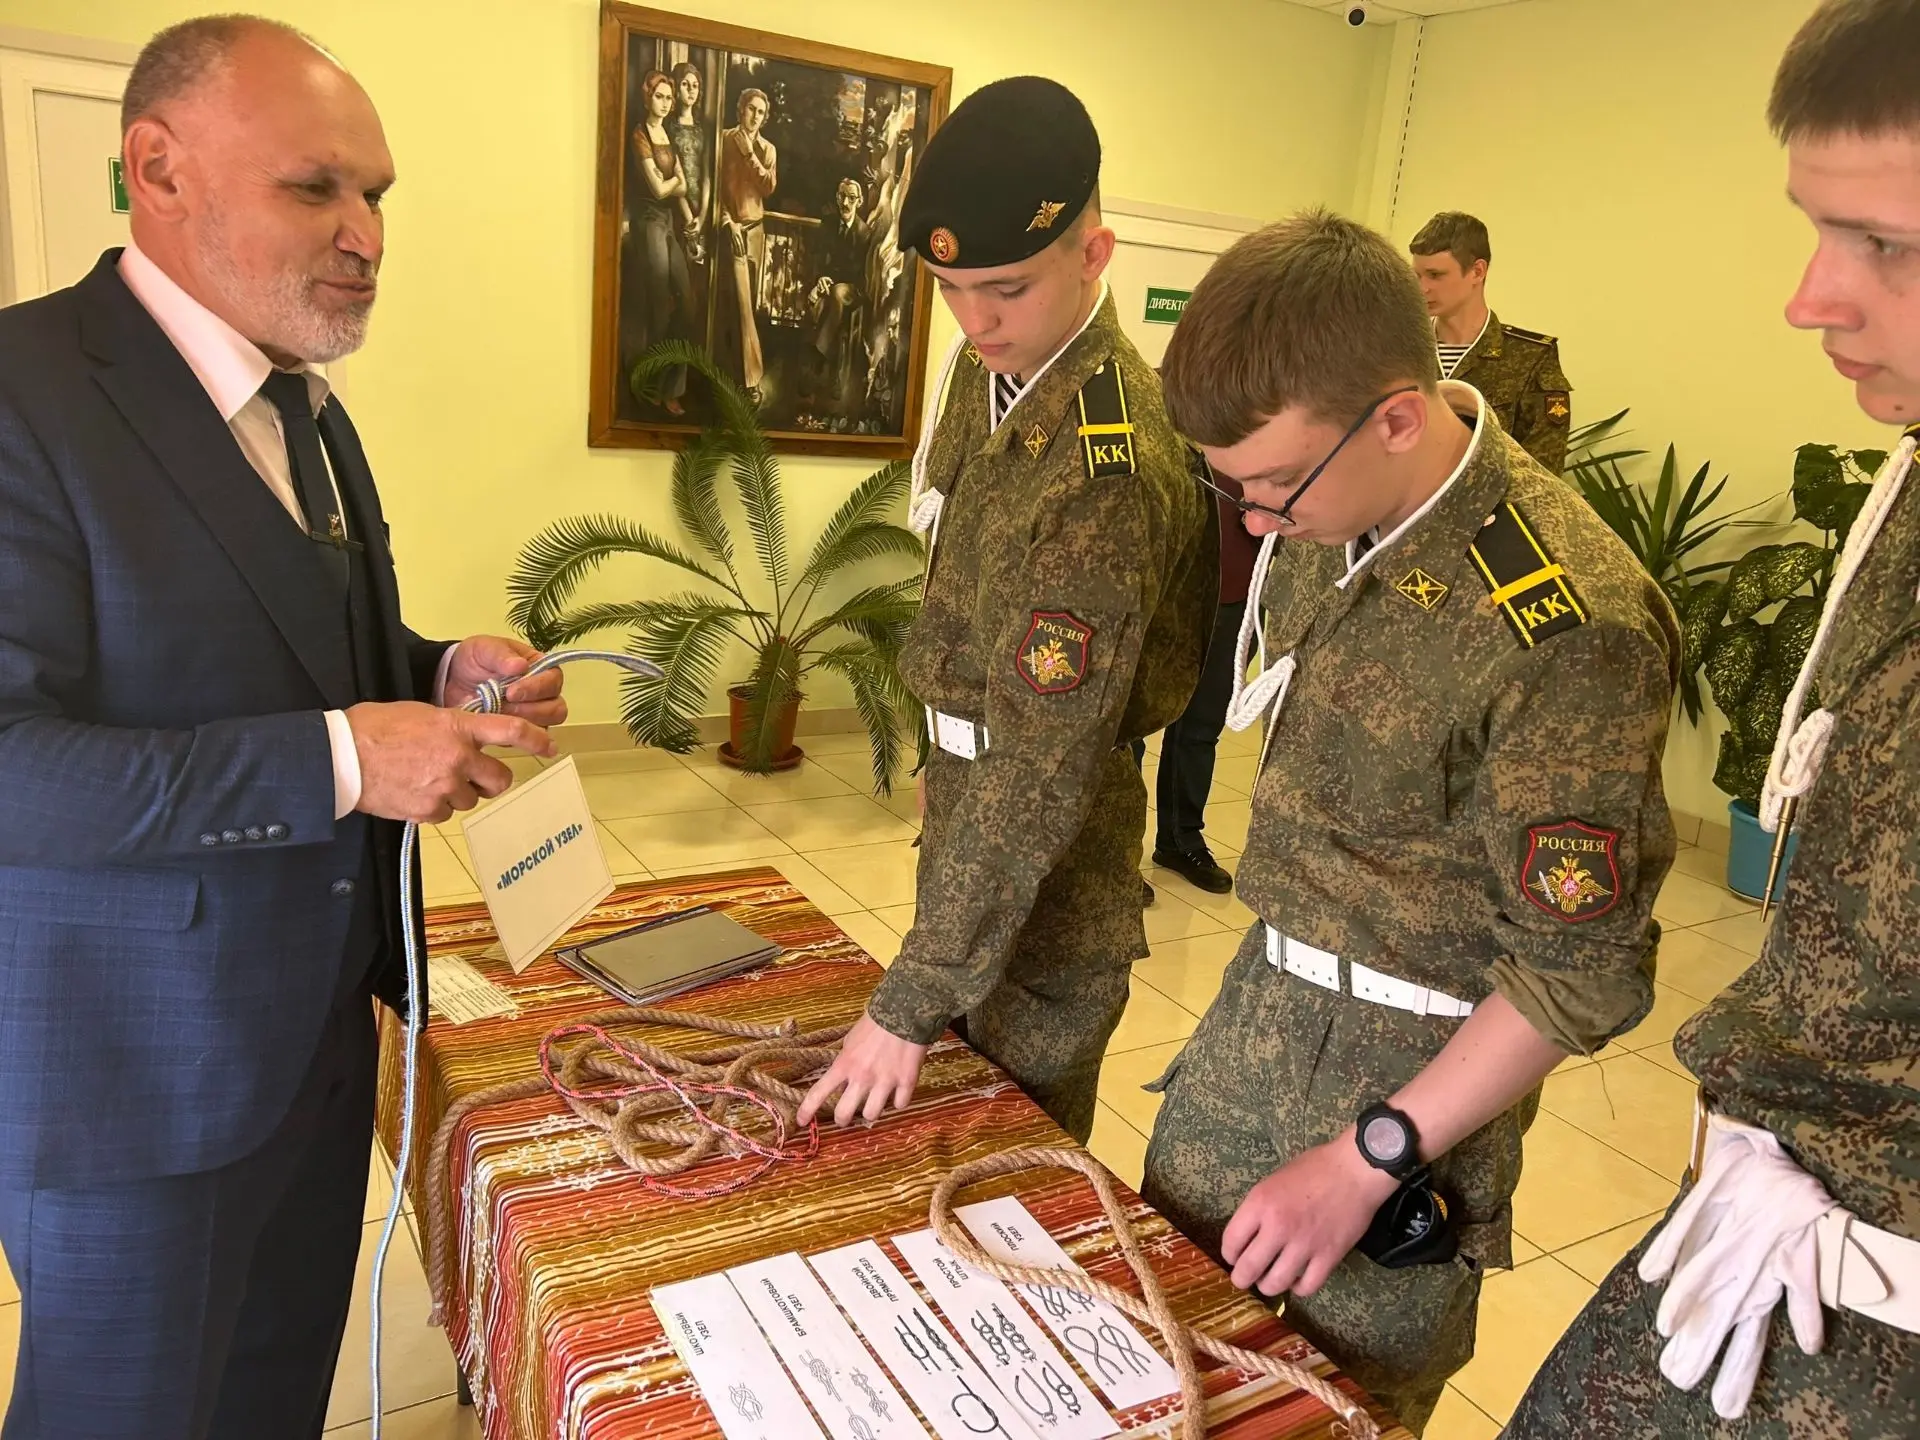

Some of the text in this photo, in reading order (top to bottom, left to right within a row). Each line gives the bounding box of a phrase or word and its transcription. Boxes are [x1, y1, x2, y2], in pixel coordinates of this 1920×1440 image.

[1148, 297, 1189, 311] ДИРЕКТО
[1036, 619, 1086, 643] РОССИЯ
[497, 823, 583, 890] «МОРСКОЙ УЗЕЛ»
[1537, 835, 1607, 852] РОССИЯ
[990, 1222, 1020, 1251] ПЛОСКИЙ
[1007, 1226, 1025, 1242] УЗЕЛ
[852, 1266, 884, 1299] ДВОЙНОЙ
[859, 1257, 899, 1302] ПРЯМОЙ УЗЕЛ
[932, 1257, 962, 1289] ПРОСТОЙ
[949, 1259, 969, 1280] ШТЫК
[760, 1277, 807, 1337] БРАМШКОТОВЫЙ
[787, 1293, 806, 1312] УЗЕЛ
[675, 1312, 705, 1356] ШКОТОВЫЙ
[694, 1320, 712, 1340] УЗЕЛ
